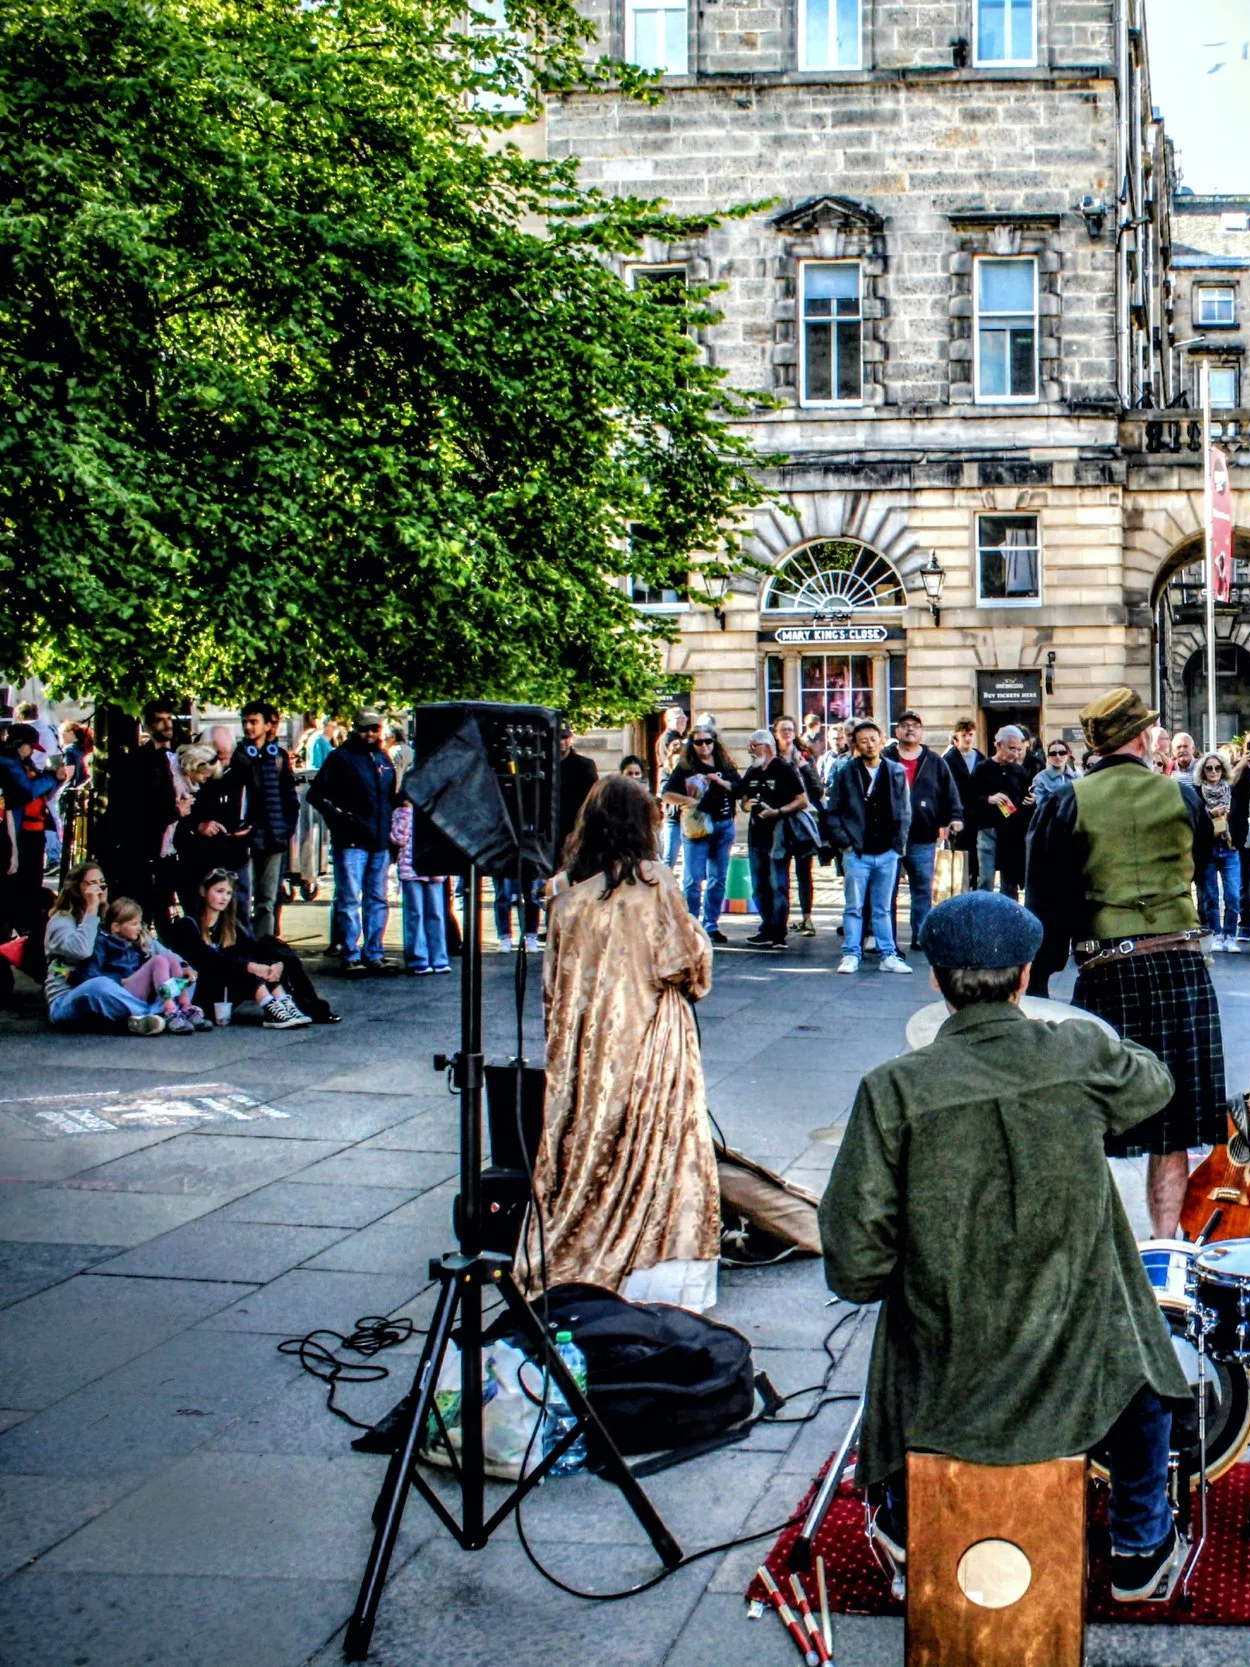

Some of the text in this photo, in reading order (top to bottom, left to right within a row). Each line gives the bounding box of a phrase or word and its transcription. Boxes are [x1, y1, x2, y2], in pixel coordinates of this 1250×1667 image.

[782, 629, 880, 641] MARY KING'S CLOSE
